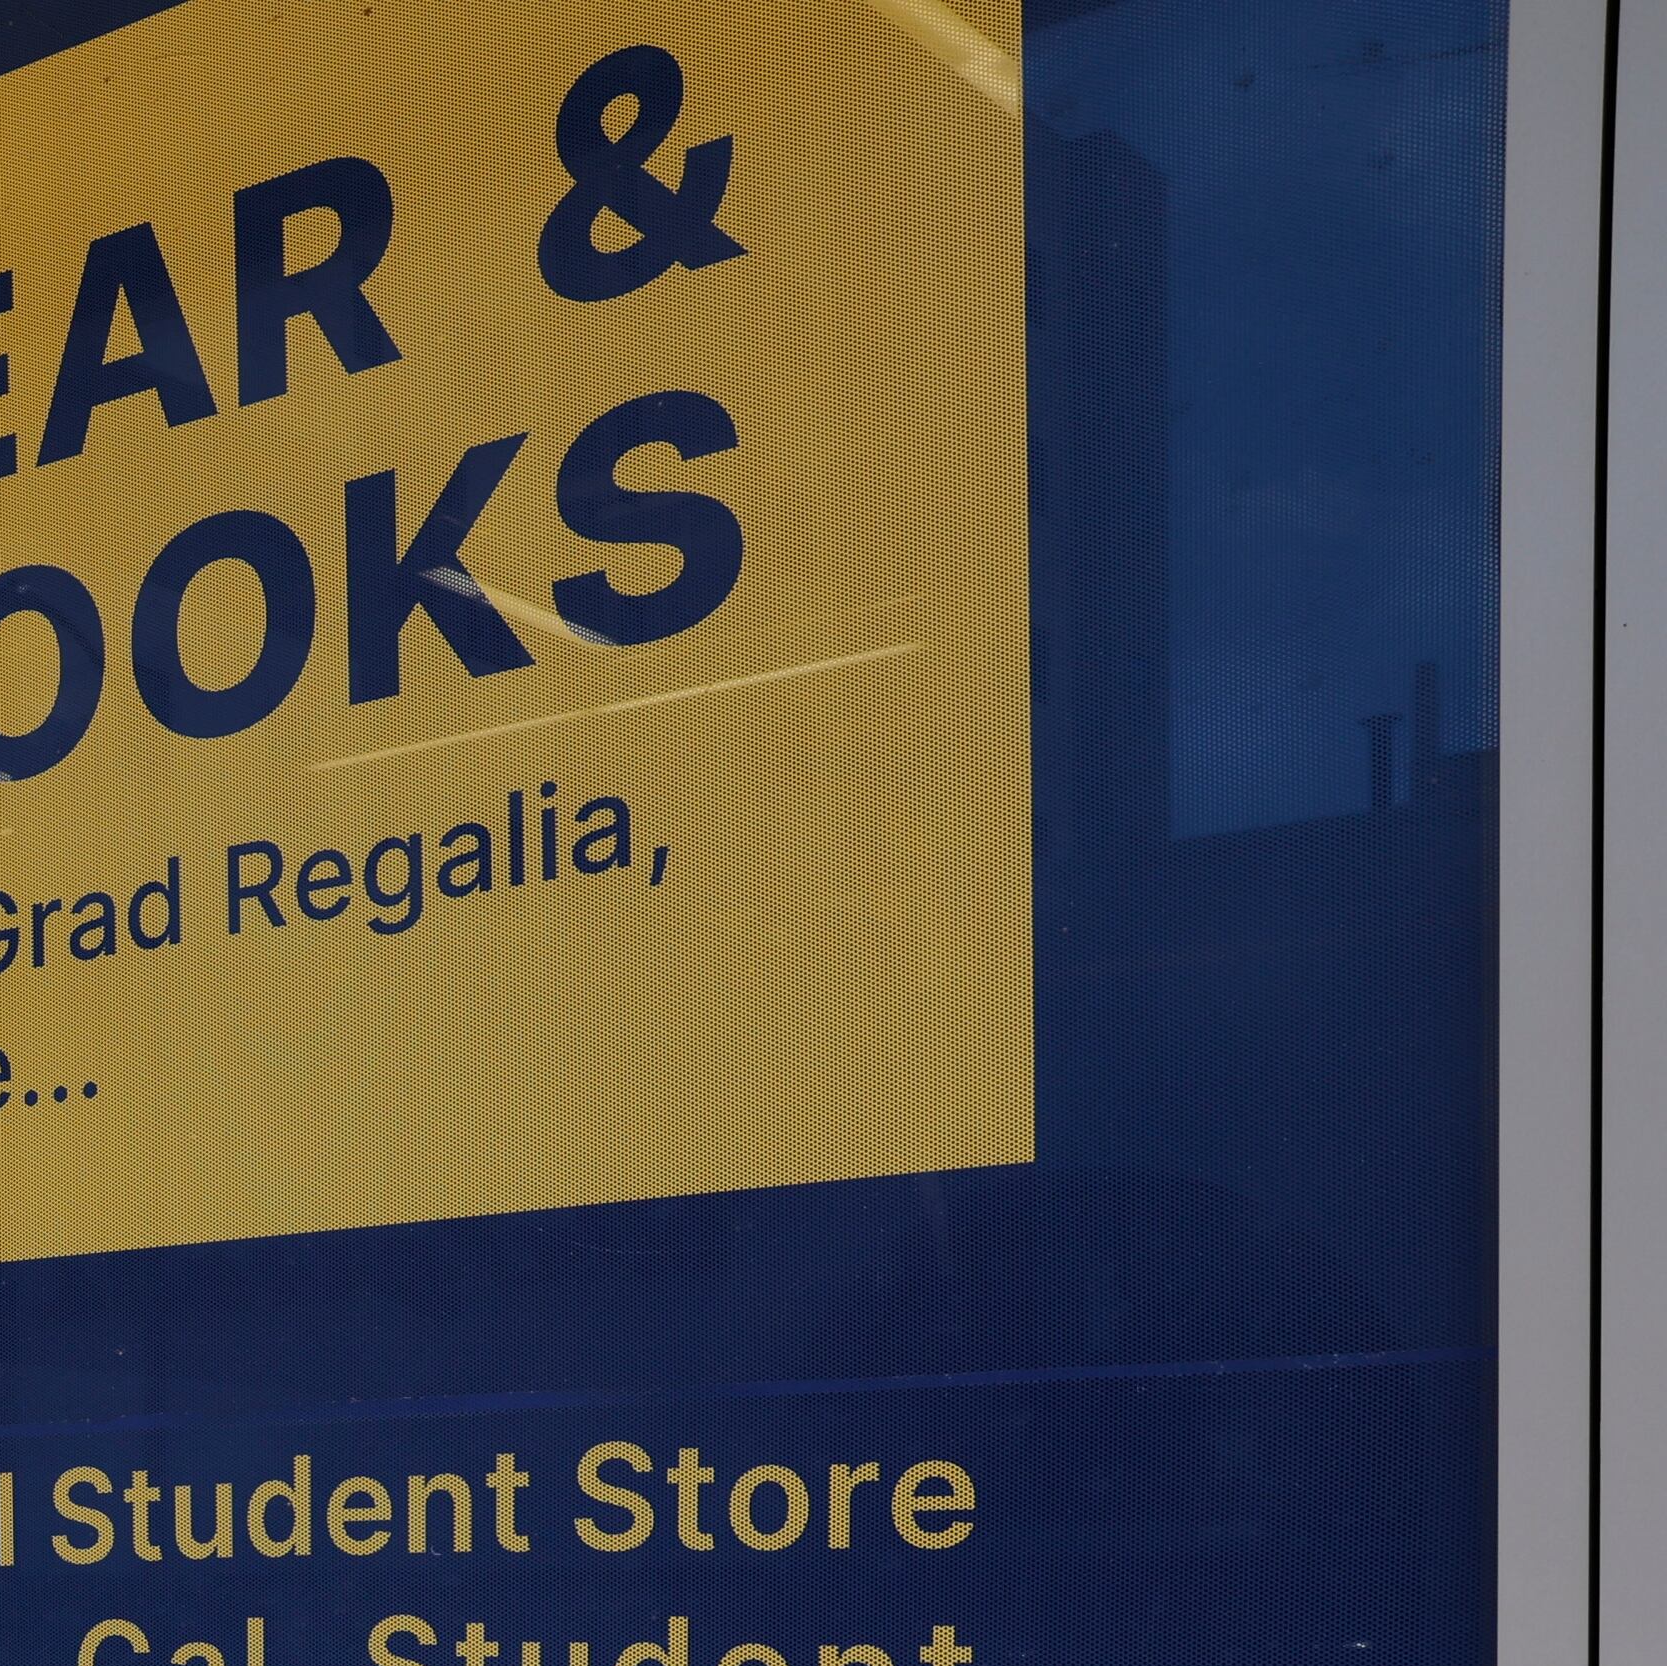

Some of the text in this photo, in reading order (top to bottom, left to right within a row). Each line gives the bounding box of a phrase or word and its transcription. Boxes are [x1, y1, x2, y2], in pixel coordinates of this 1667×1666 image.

[536, 44, 747, 304] &
[225, 780, 671, 938] Regalia,
[52, 1454, 530, 1565] Student
[574, 1441, 976, 1552] Store
